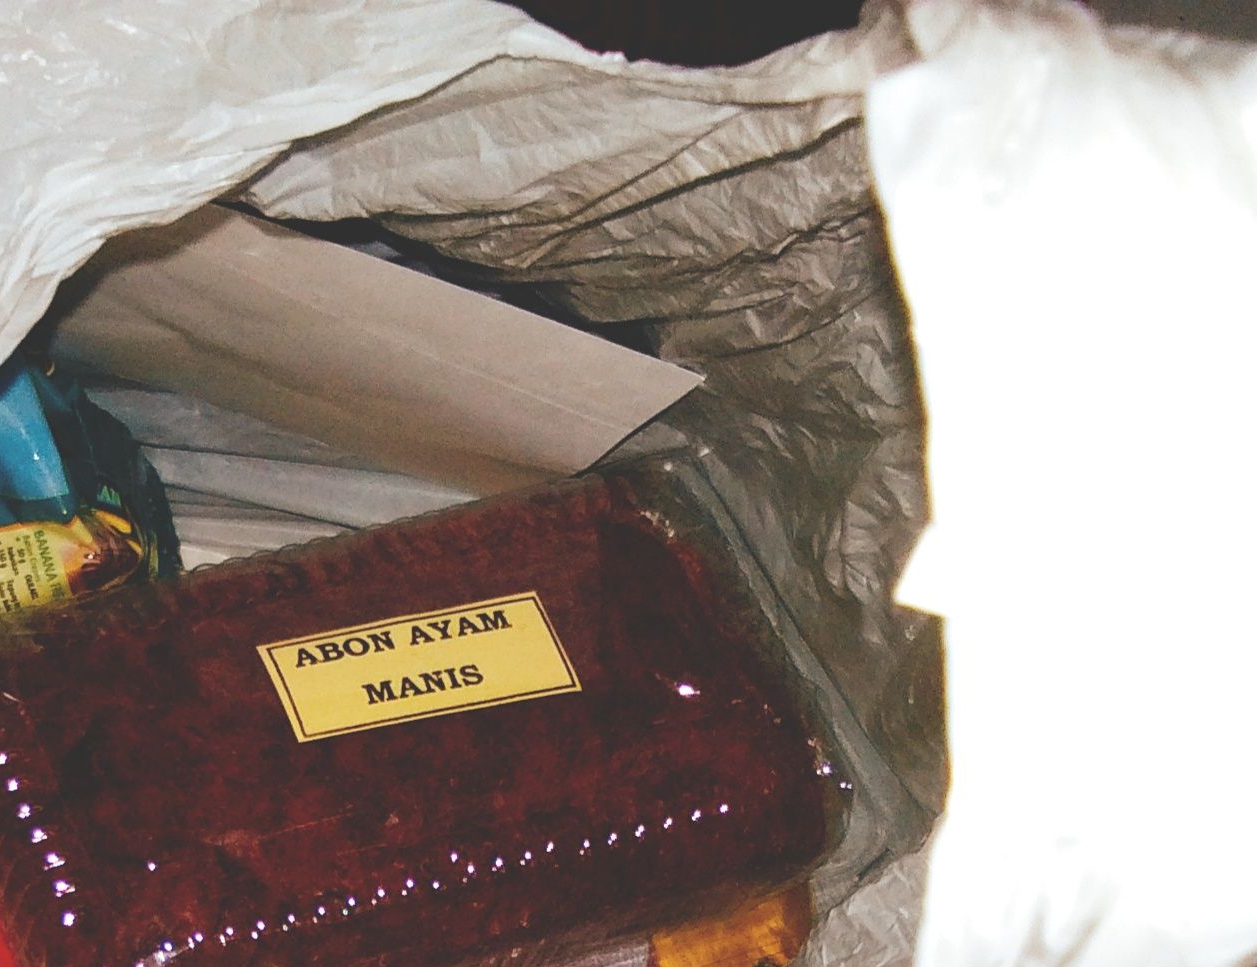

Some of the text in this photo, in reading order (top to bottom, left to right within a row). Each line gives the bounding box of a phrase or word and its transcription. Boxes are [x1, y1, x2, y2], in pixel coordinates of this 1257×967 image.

[33, 529, 57, 582] BANANA
[295, 610, 512, 668] ABON AYAM
[361, 664, 484, 705] MANIS
